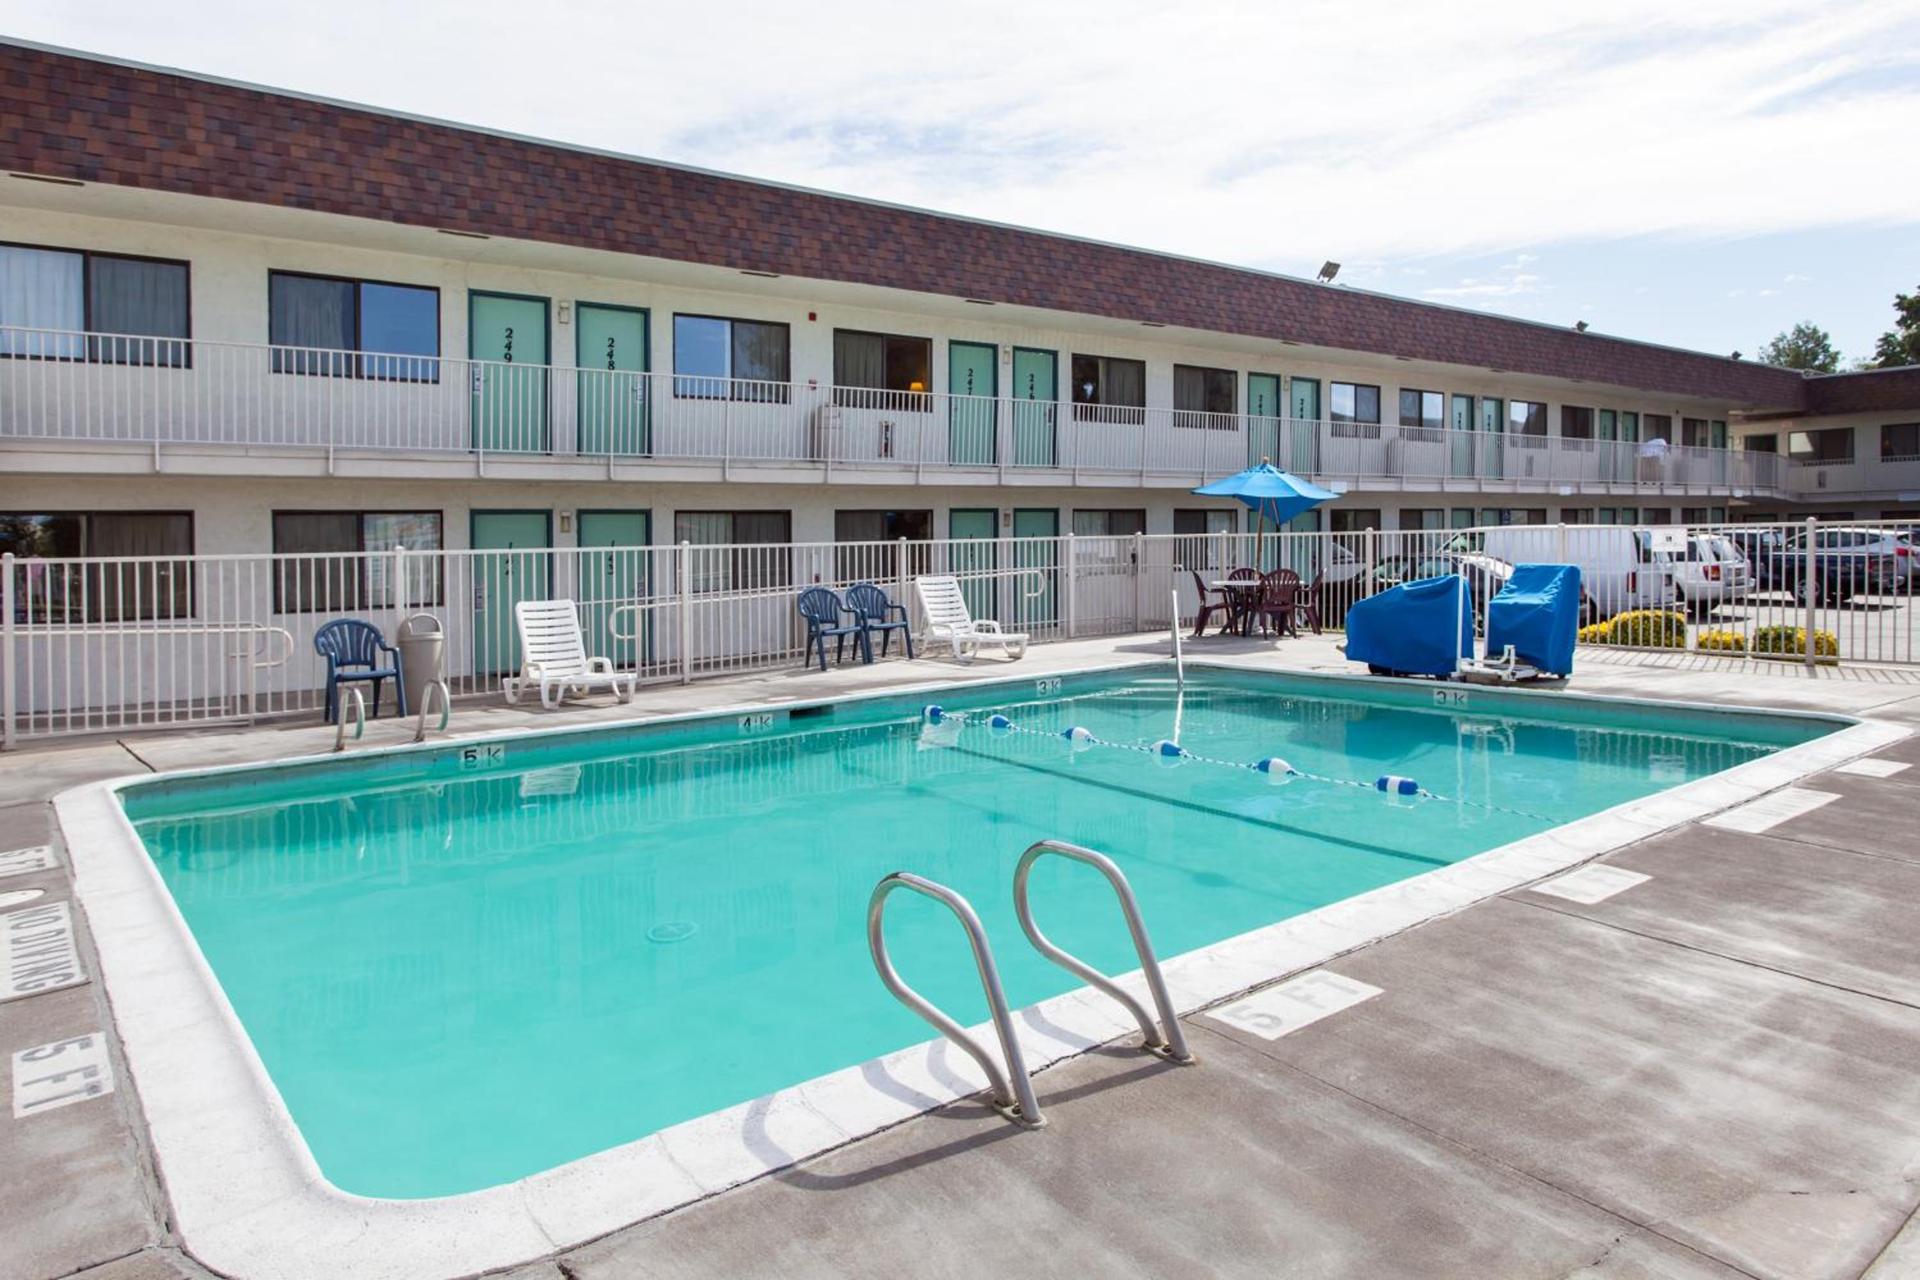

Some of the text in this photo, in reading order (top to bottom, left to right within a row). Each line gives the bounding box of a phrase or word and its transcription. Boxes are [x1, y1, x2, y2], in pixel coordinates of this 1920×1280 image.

[503, 327, 513, 362] 249
[606, 337, 615, 371] 248
[8, 904, 75, 991] NO DIVING
[1222, 974, 1361, 1030] 5 FT
[20, 1036, 93, 1062] 5
